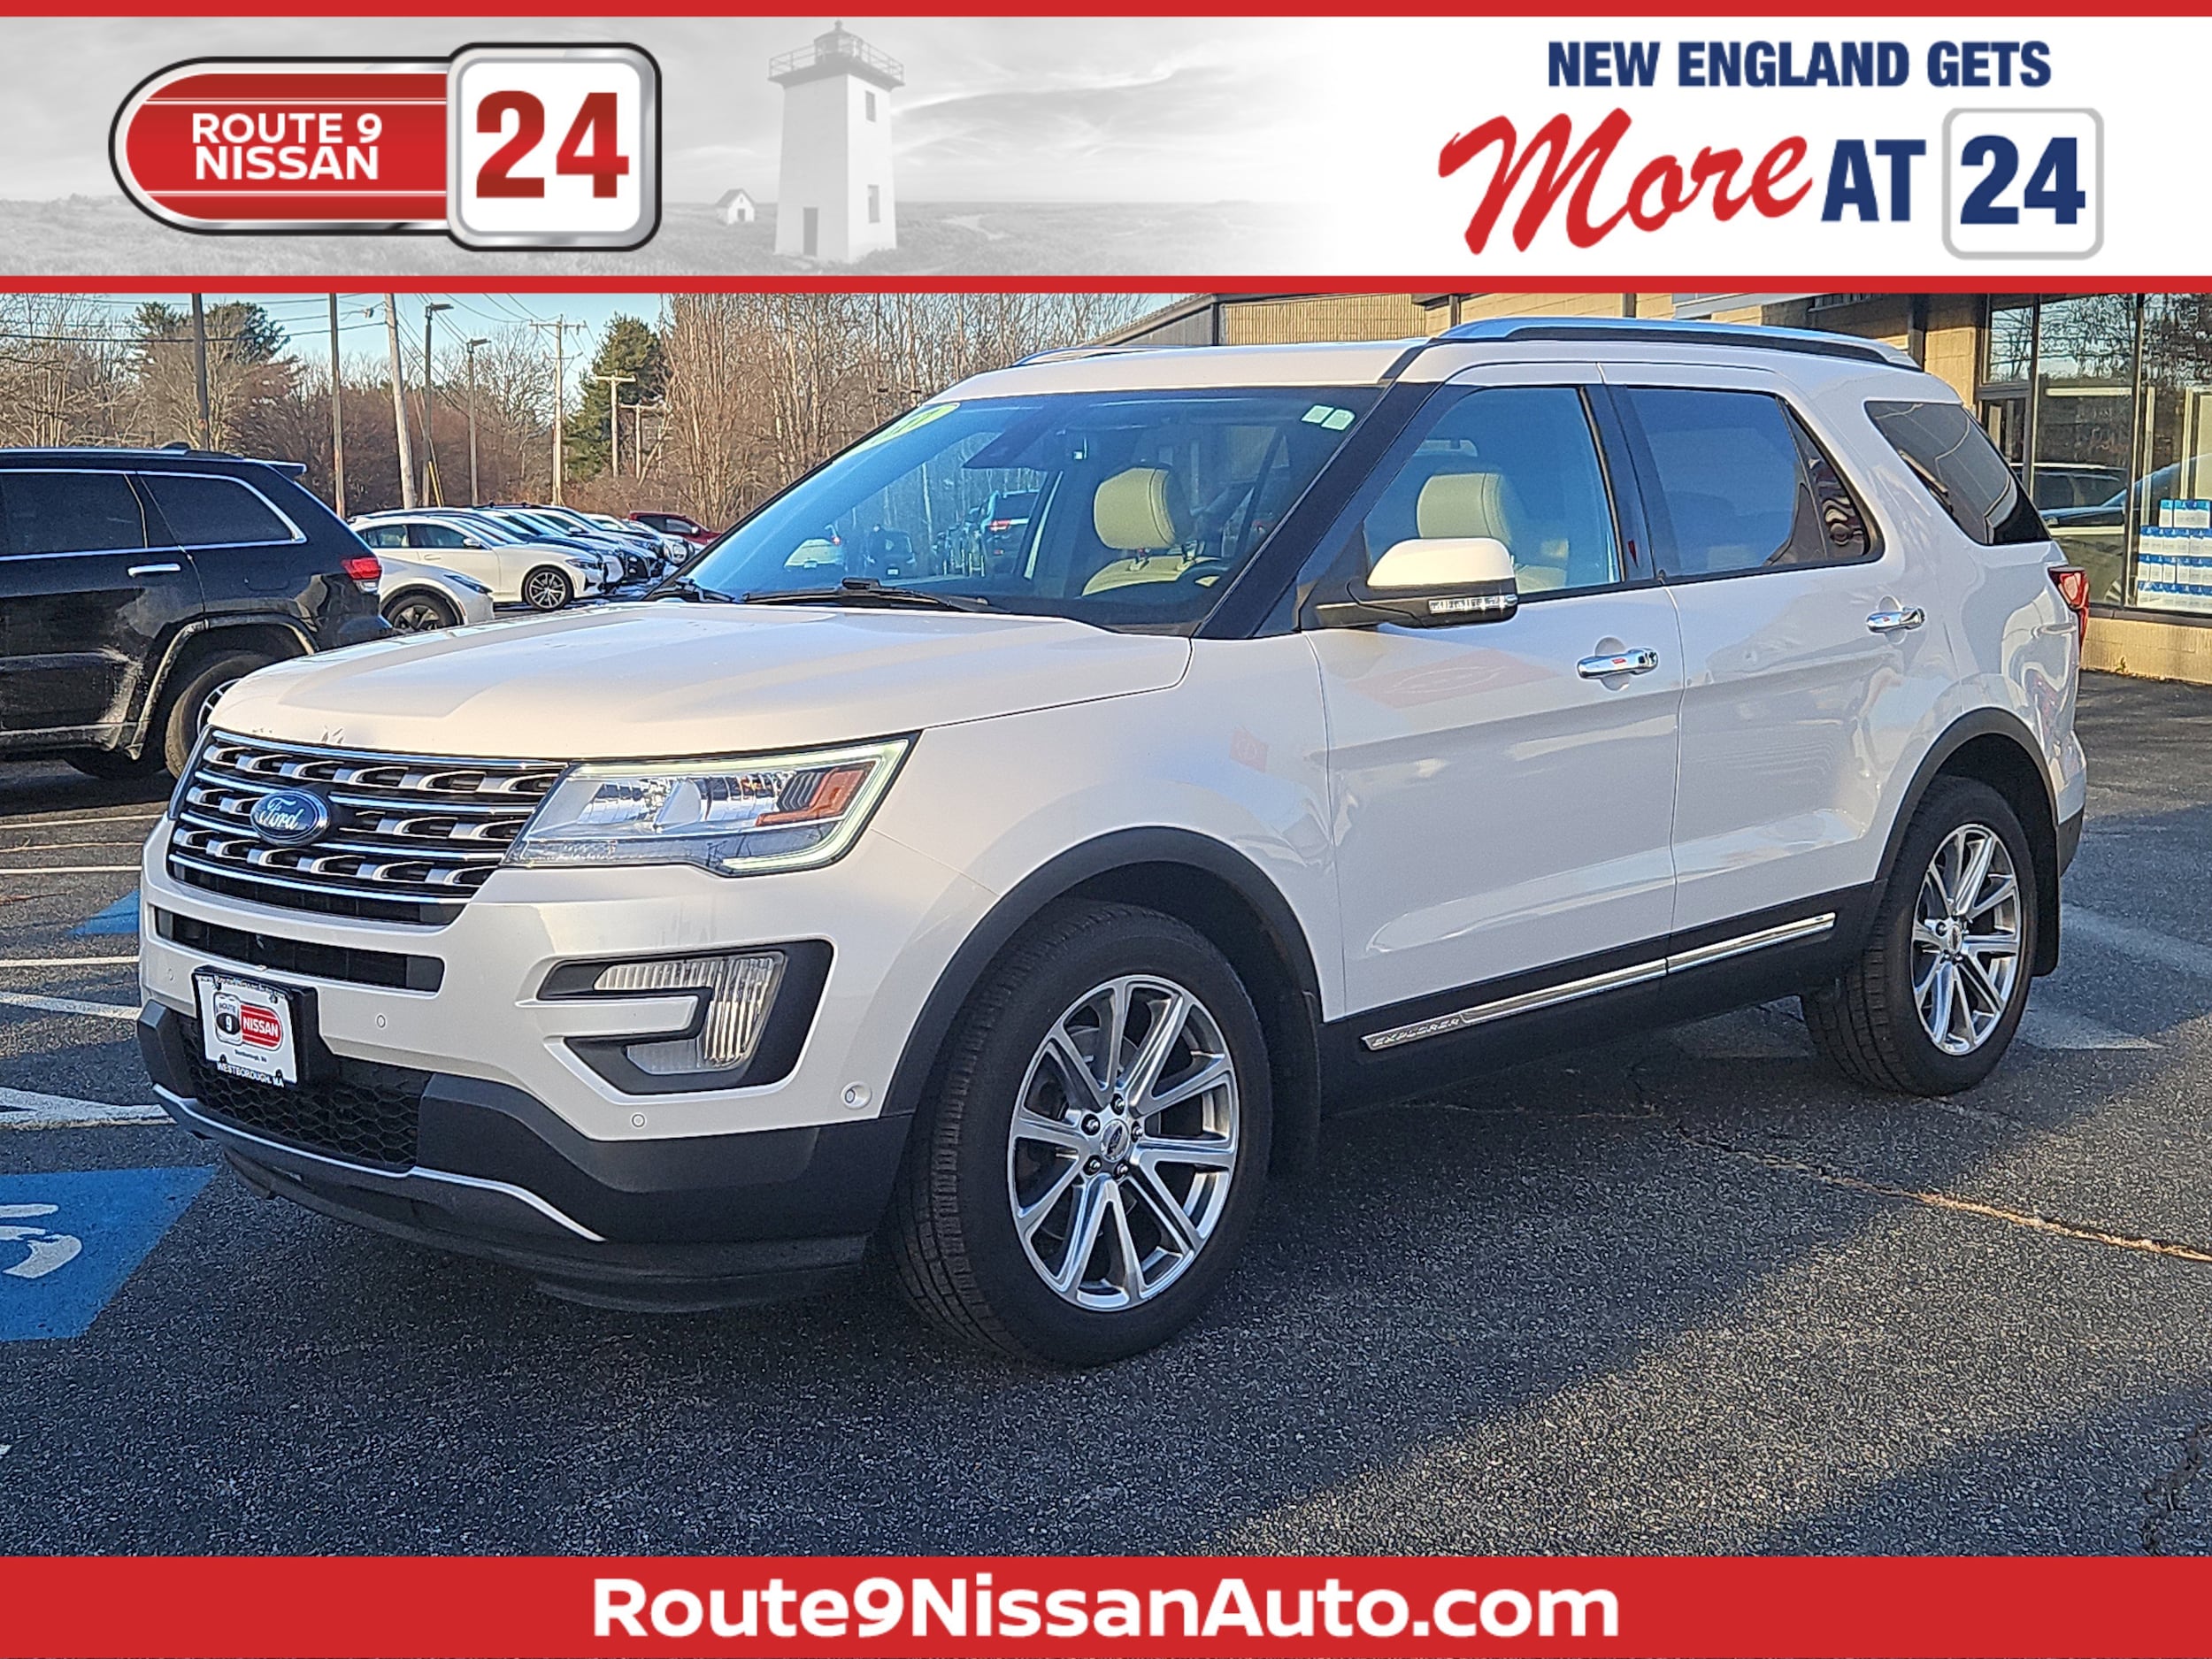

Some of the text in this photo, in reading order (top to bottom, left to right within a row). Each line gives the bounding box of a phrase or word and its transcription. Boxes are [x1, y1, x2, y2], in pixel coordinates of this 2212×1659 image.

[259, 797, 304, 830] Ford
[225, 1016, 233, 1032] 9
[242, 1016, 278, 1037] NISSAN
[1372, 1018, 1460, 1047] EXPLORER
